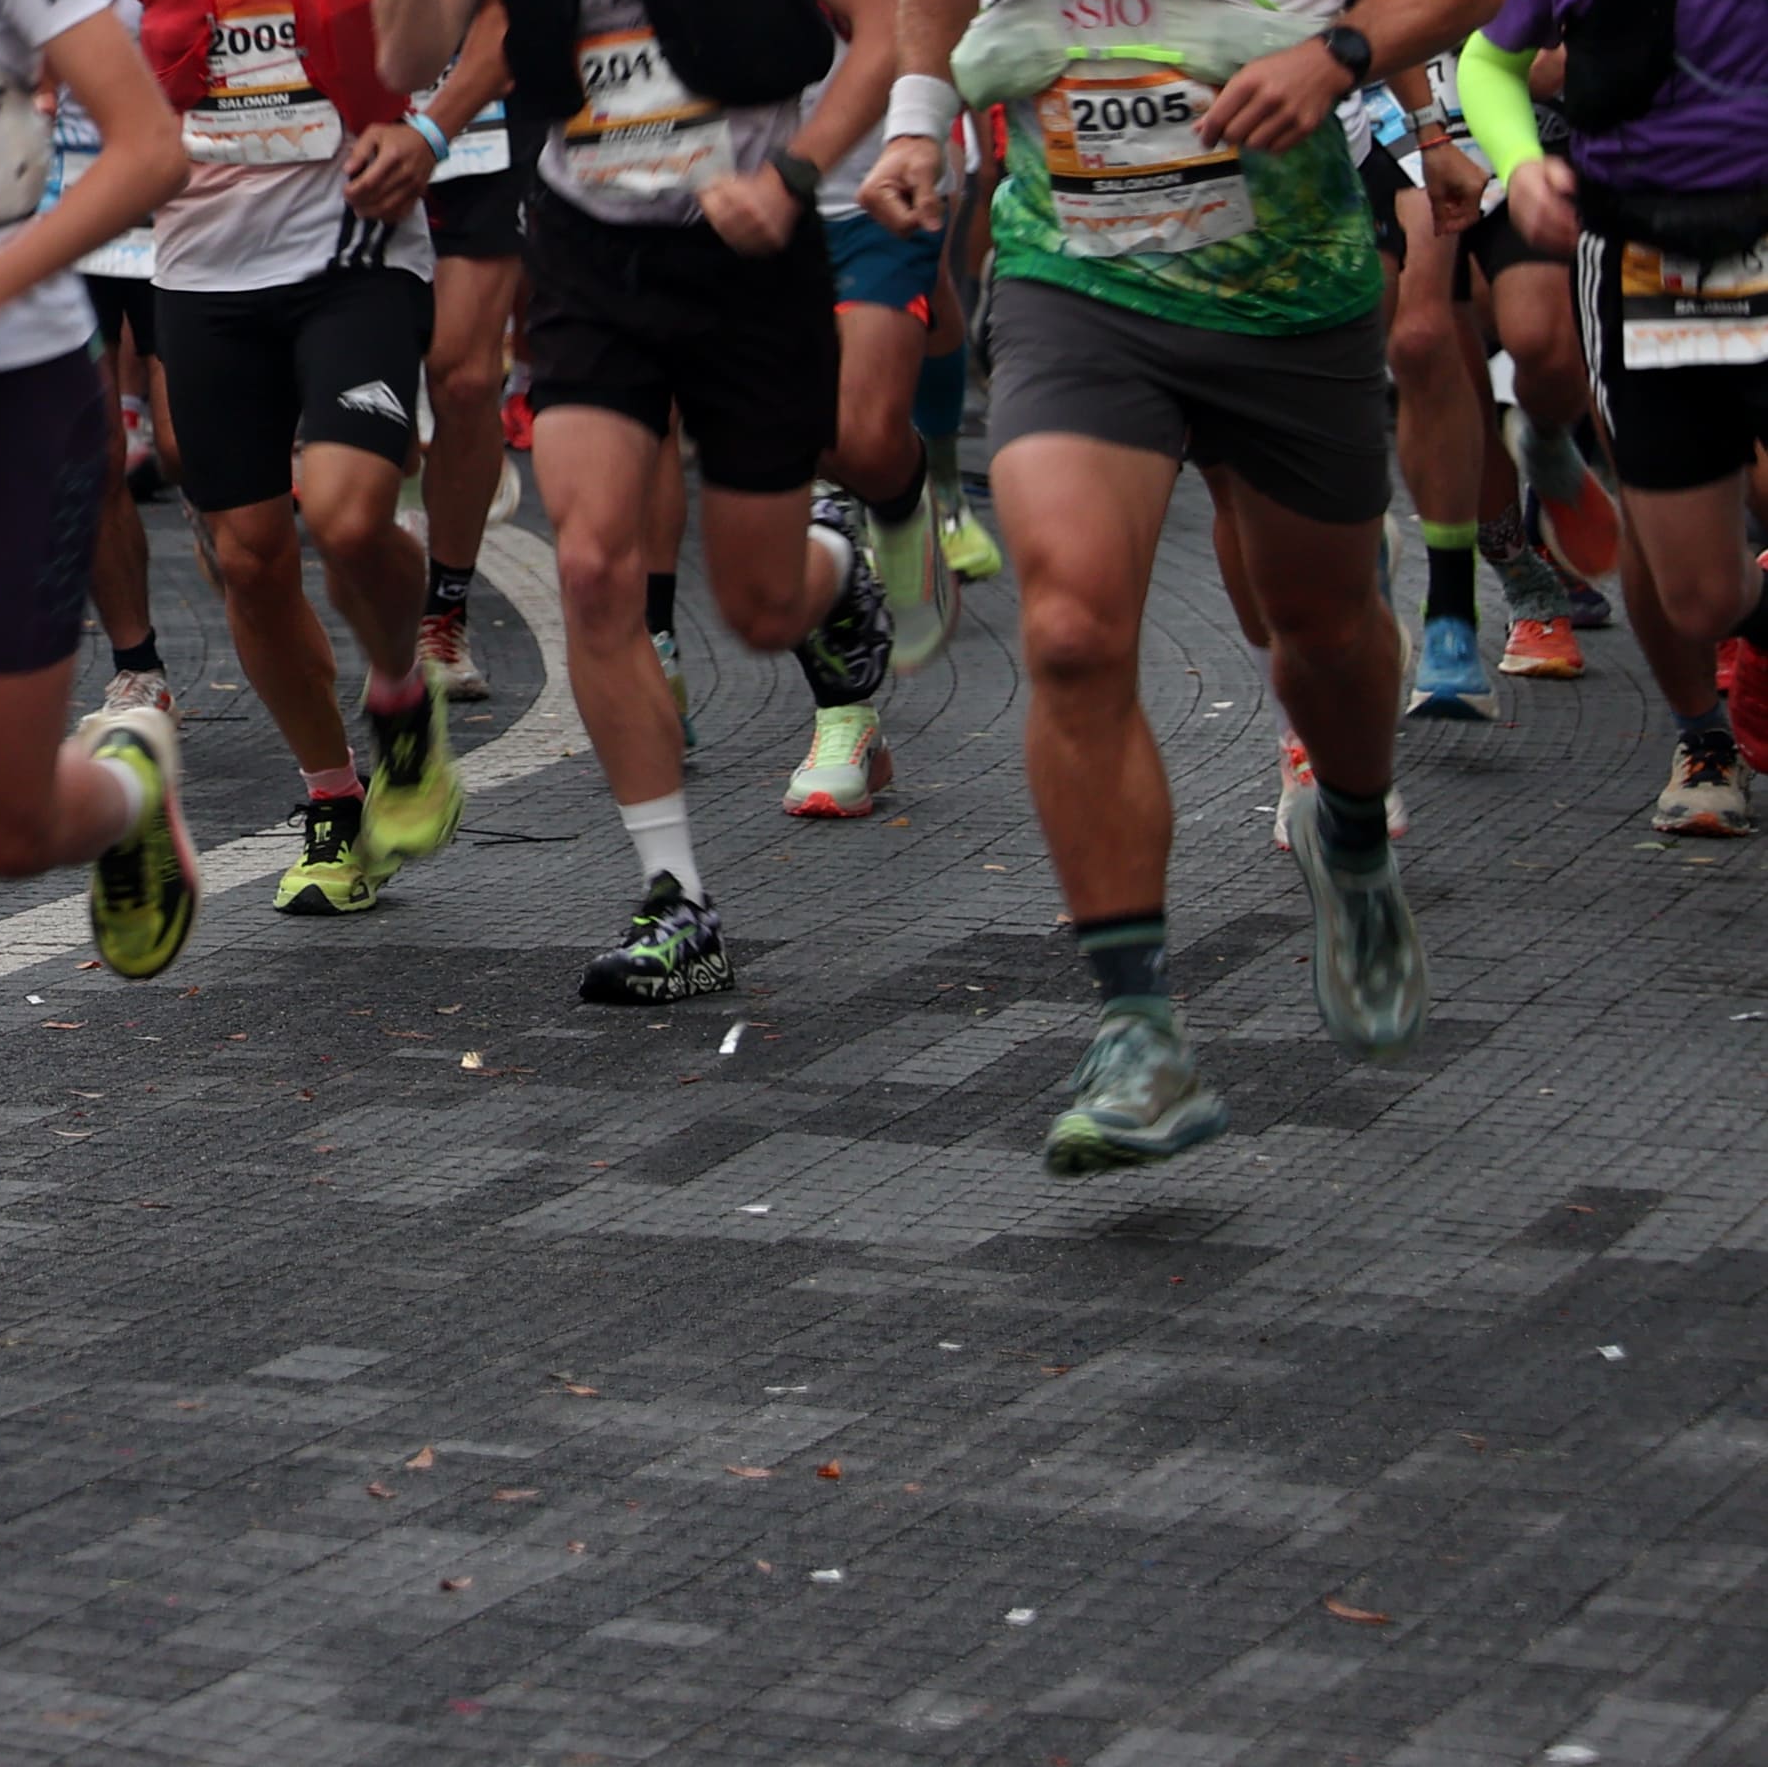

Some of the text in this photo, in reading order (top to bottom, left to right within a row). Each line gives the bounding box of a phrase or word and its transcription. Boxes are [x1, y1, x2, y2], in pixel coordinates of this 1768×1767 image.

[207, 21, 296, 56] 2009
[217, 92, 290, 111] SALOMON
[1072, 91, 1192, 132] 2005
